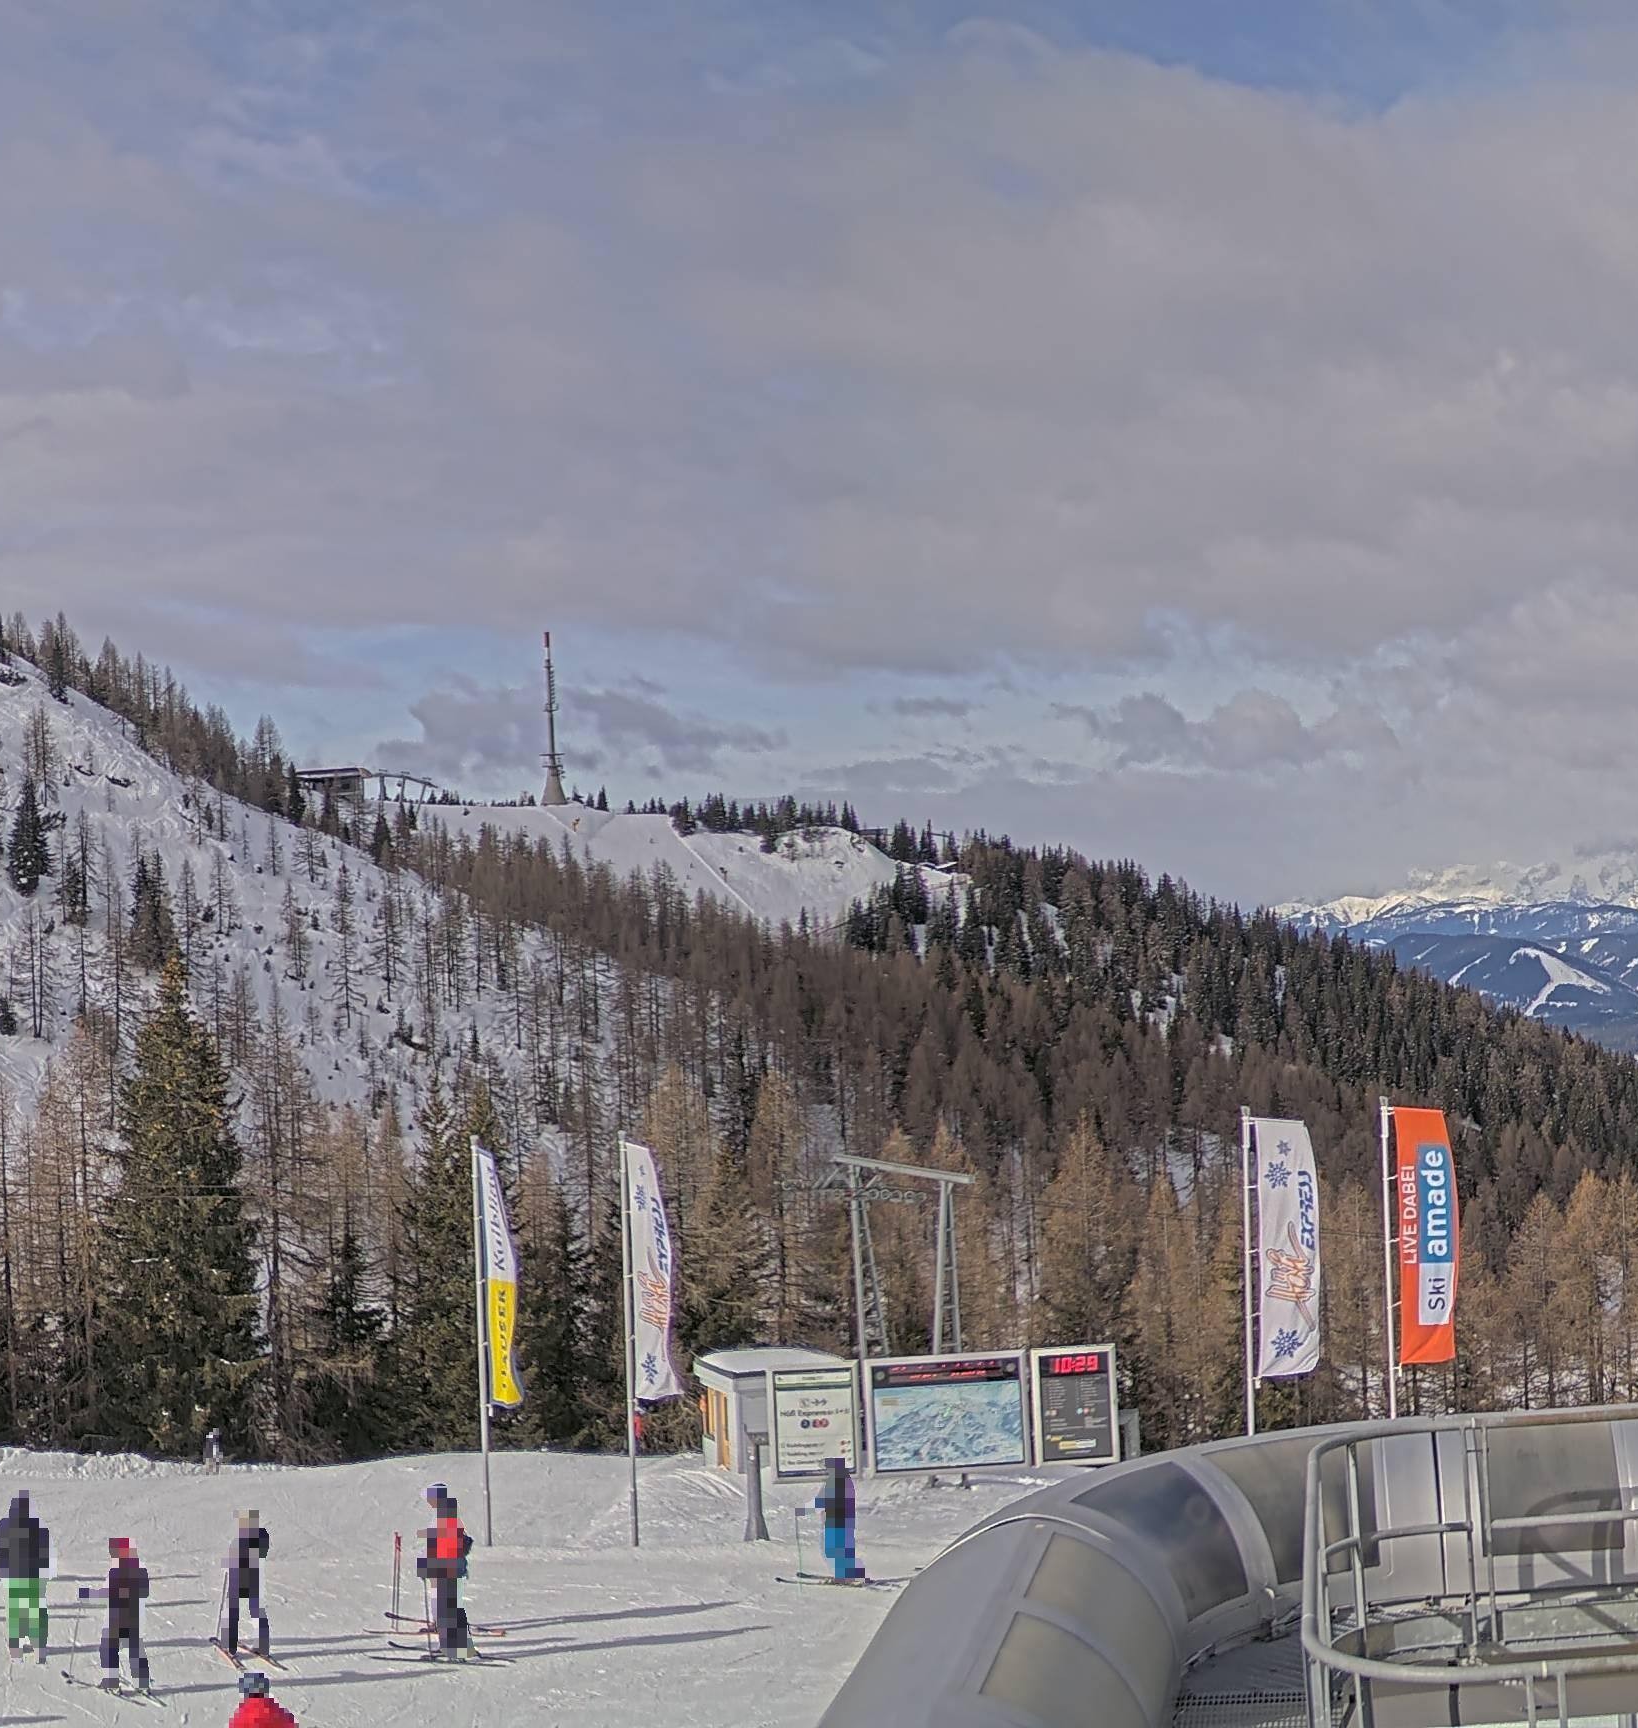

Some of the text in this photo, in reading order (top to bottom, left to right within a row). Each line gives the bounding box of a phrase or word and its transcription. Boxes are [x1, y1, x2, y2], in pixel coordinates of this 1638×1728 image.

[1401, 1165, 1418, 1264] LIVE DABEI
[1428, 1277, 1445, 1310] Ski
[1054, 1355, 1099, 1373] 10:29
